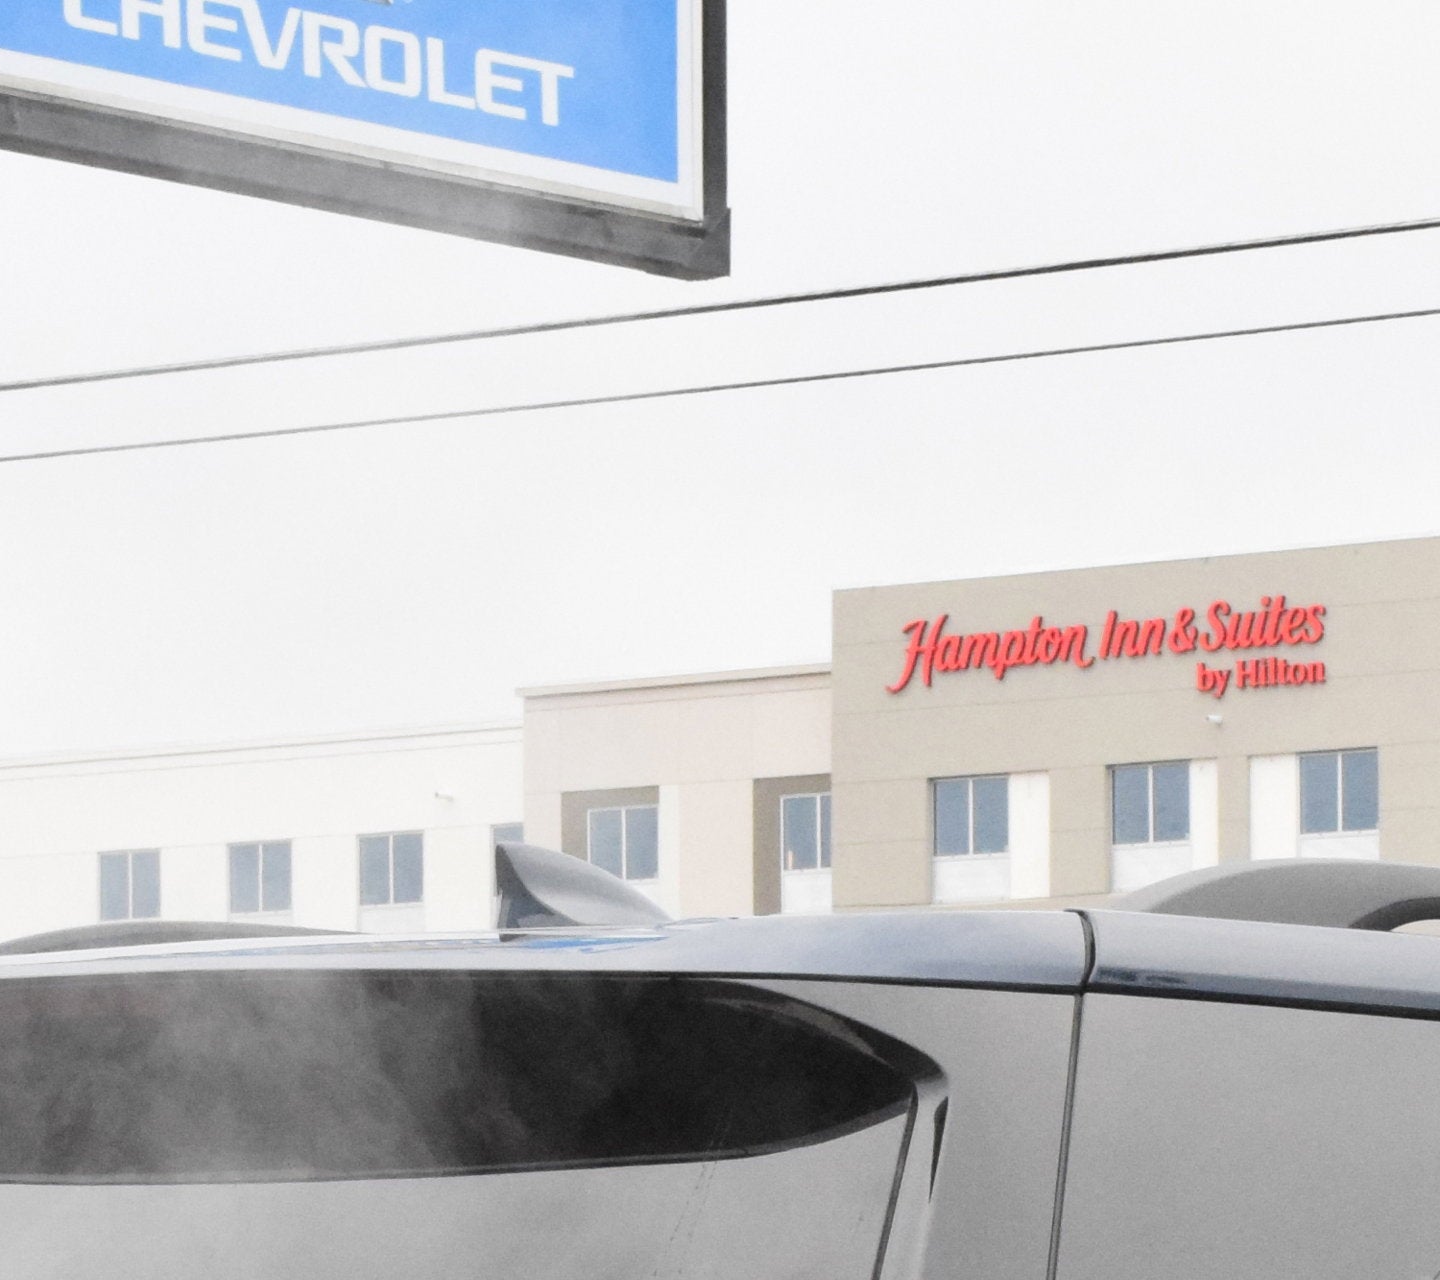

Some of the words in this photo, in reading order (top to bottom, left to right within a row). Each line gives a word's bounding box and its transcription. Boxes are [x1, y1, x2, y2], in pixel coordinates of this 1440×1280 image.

[63, 0, 575, 127] CHEVROLET
[886, 613, 1094, 695] Hampton
[1098, 609, 1166, 661] Inn
[1199, 595, 1327, 653] Suites
[1196, 662, 1230, 698] by
[1235, 658, 1327, 689] Hilton
